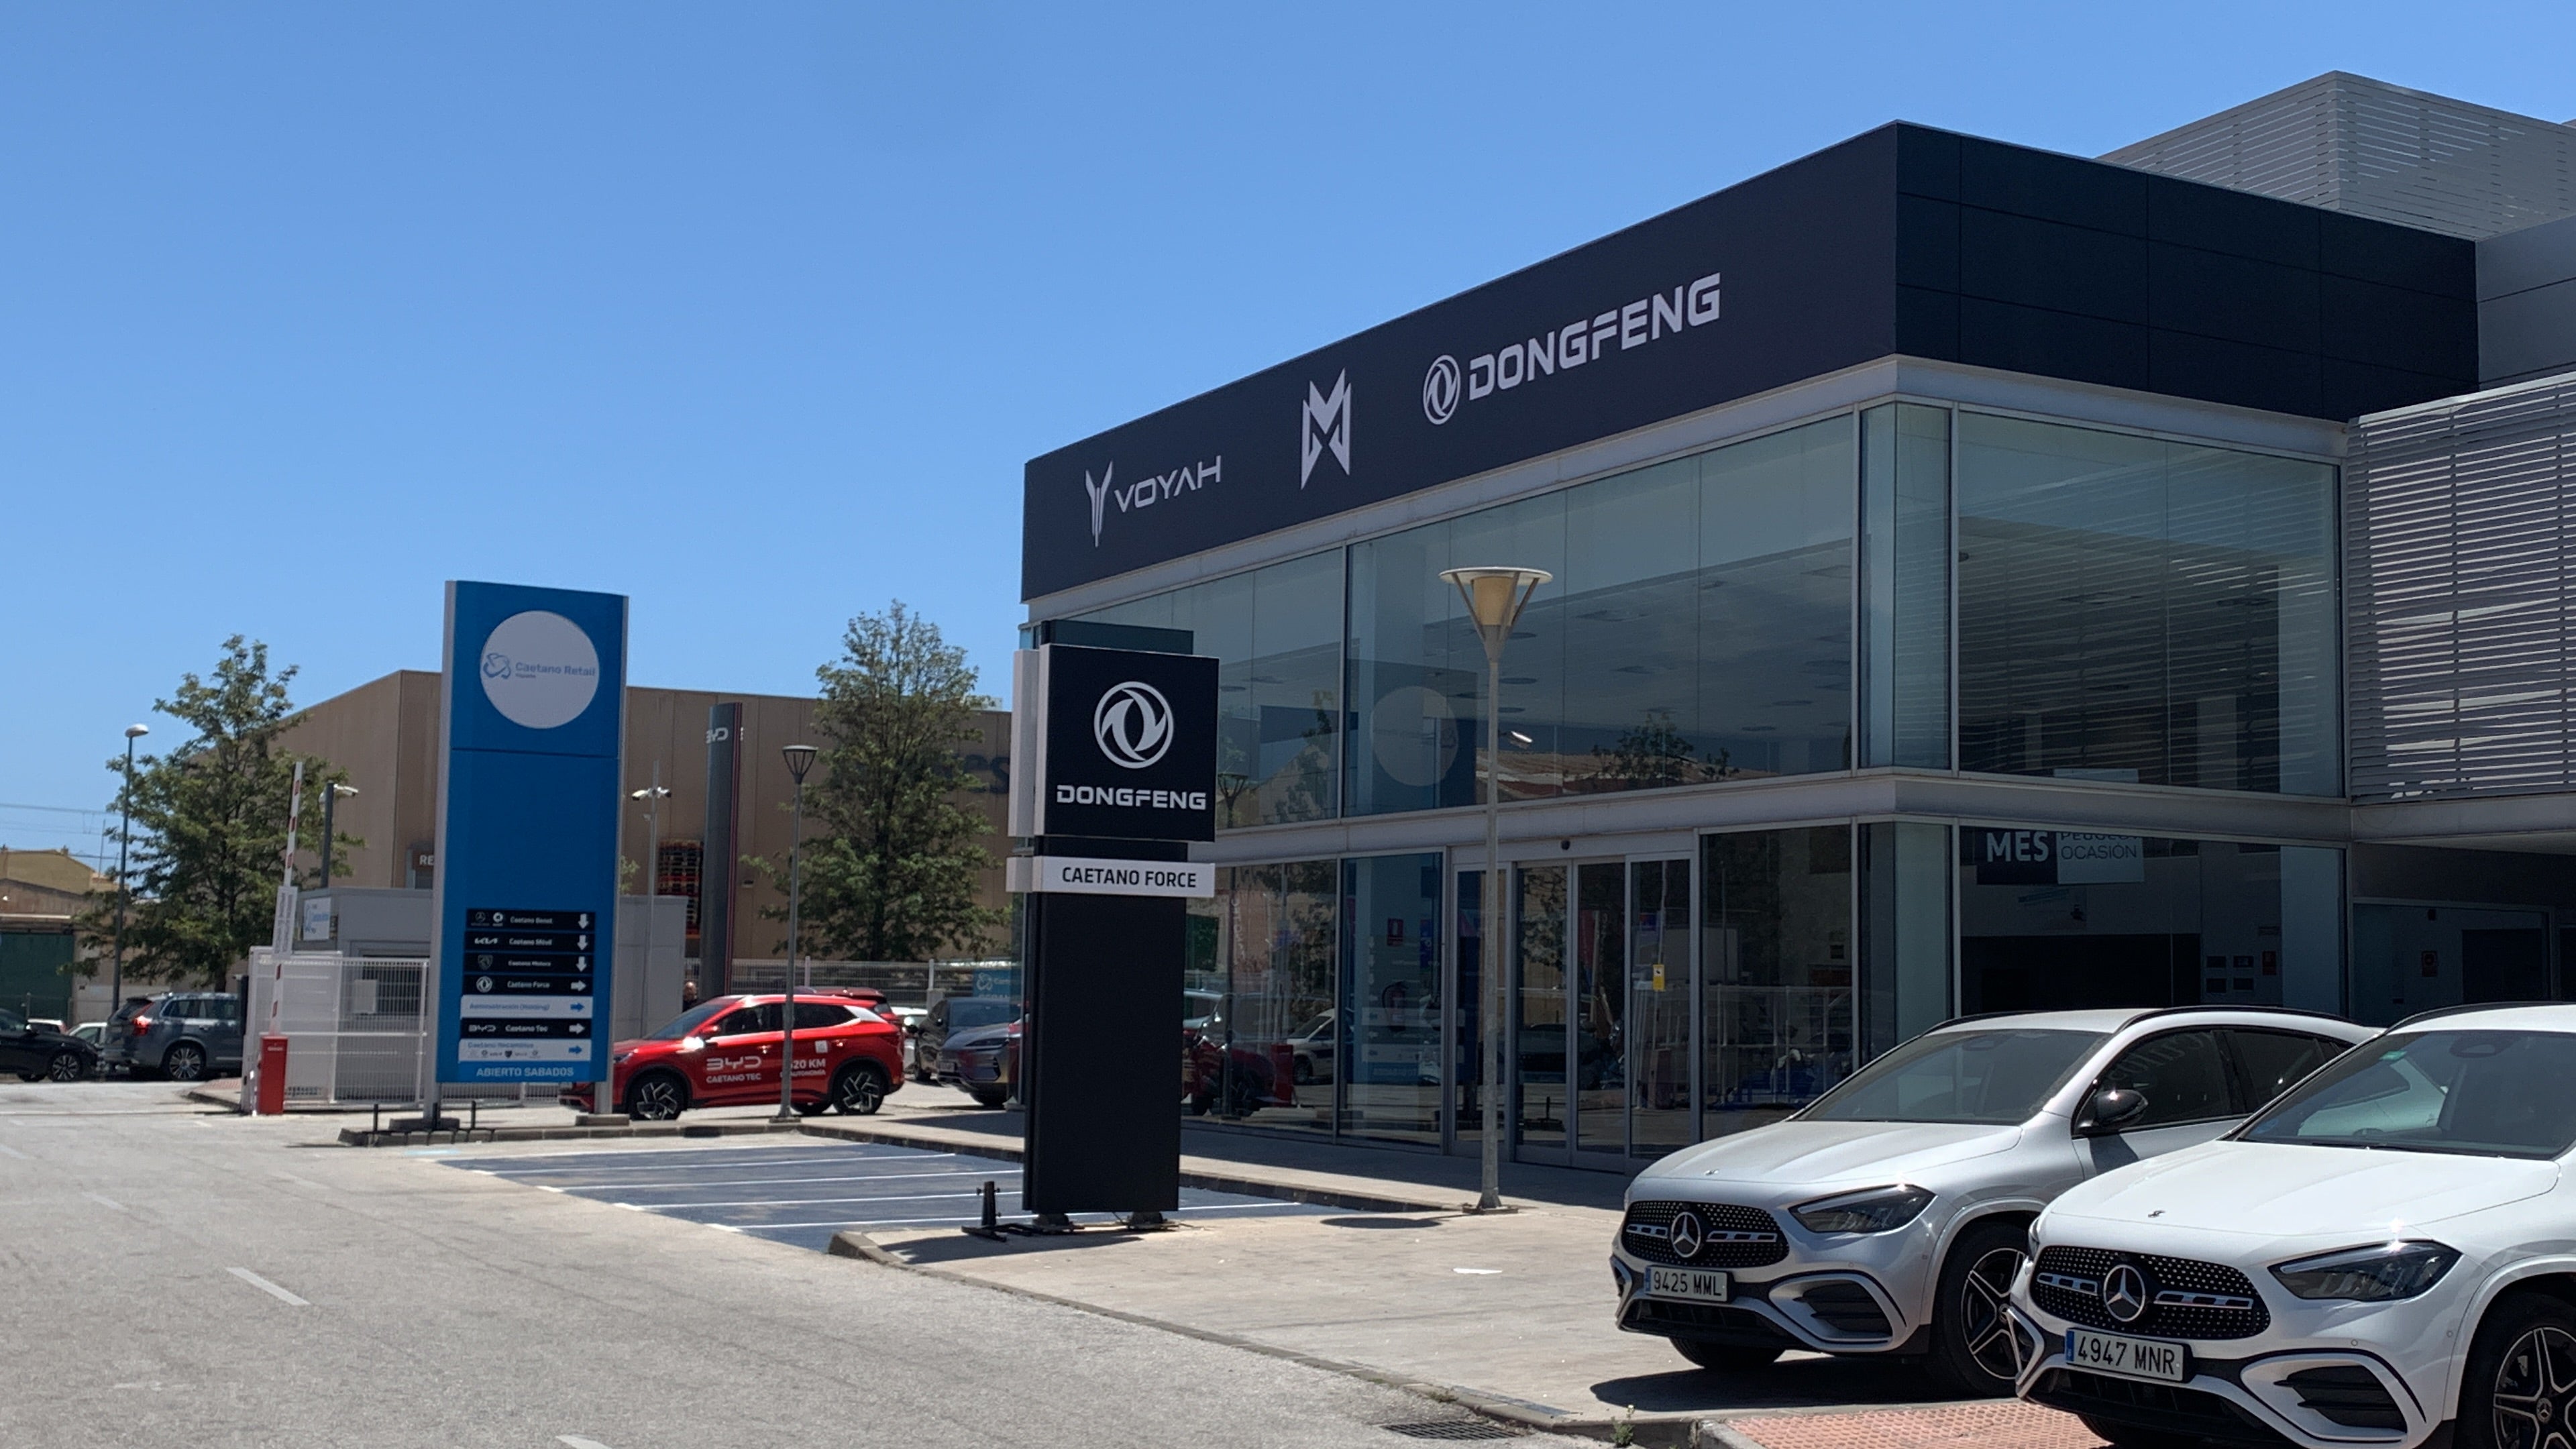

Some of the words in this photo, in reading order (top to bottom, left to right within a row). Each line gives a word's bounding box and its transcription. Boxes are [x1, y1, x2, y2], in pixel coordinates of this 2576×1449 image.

[1469, 272, 1721, 400] DONGFENG
[1114, 455, 1221, 513] VOYAH
[515, 661, 561, 674] Caetano
[564, 665, 596, 676] Retail
[1057, 785, 1207, 810] DONGFENG
[1987, 830, 2049, 862] MES
[2060, 832, 2137, 841] PEUG
[2061, 843, 2137, 859] OCASIÓN
[1062, 866, 1140, 886] CAETANO
[1144, 871, 1197, 888] FORCE
[476, 1067, 523, 1077] ABIERTO
[524, 1067, 574, 1077] SABADOS
[706, 1055, 761, 1071] BYD
[791, 1060, 806, 1069] 20
[809, 1059, 826, 1068] KM
[706, 1075, 745, 1083] CAETANO
[1654, 1271, 1688, 1293] 9425
[1693, 1274, 1722, 1296] MML
[2078, 1336, 2127, 1366] 4947
[2134, 1344, 2174, 1375] MNR
